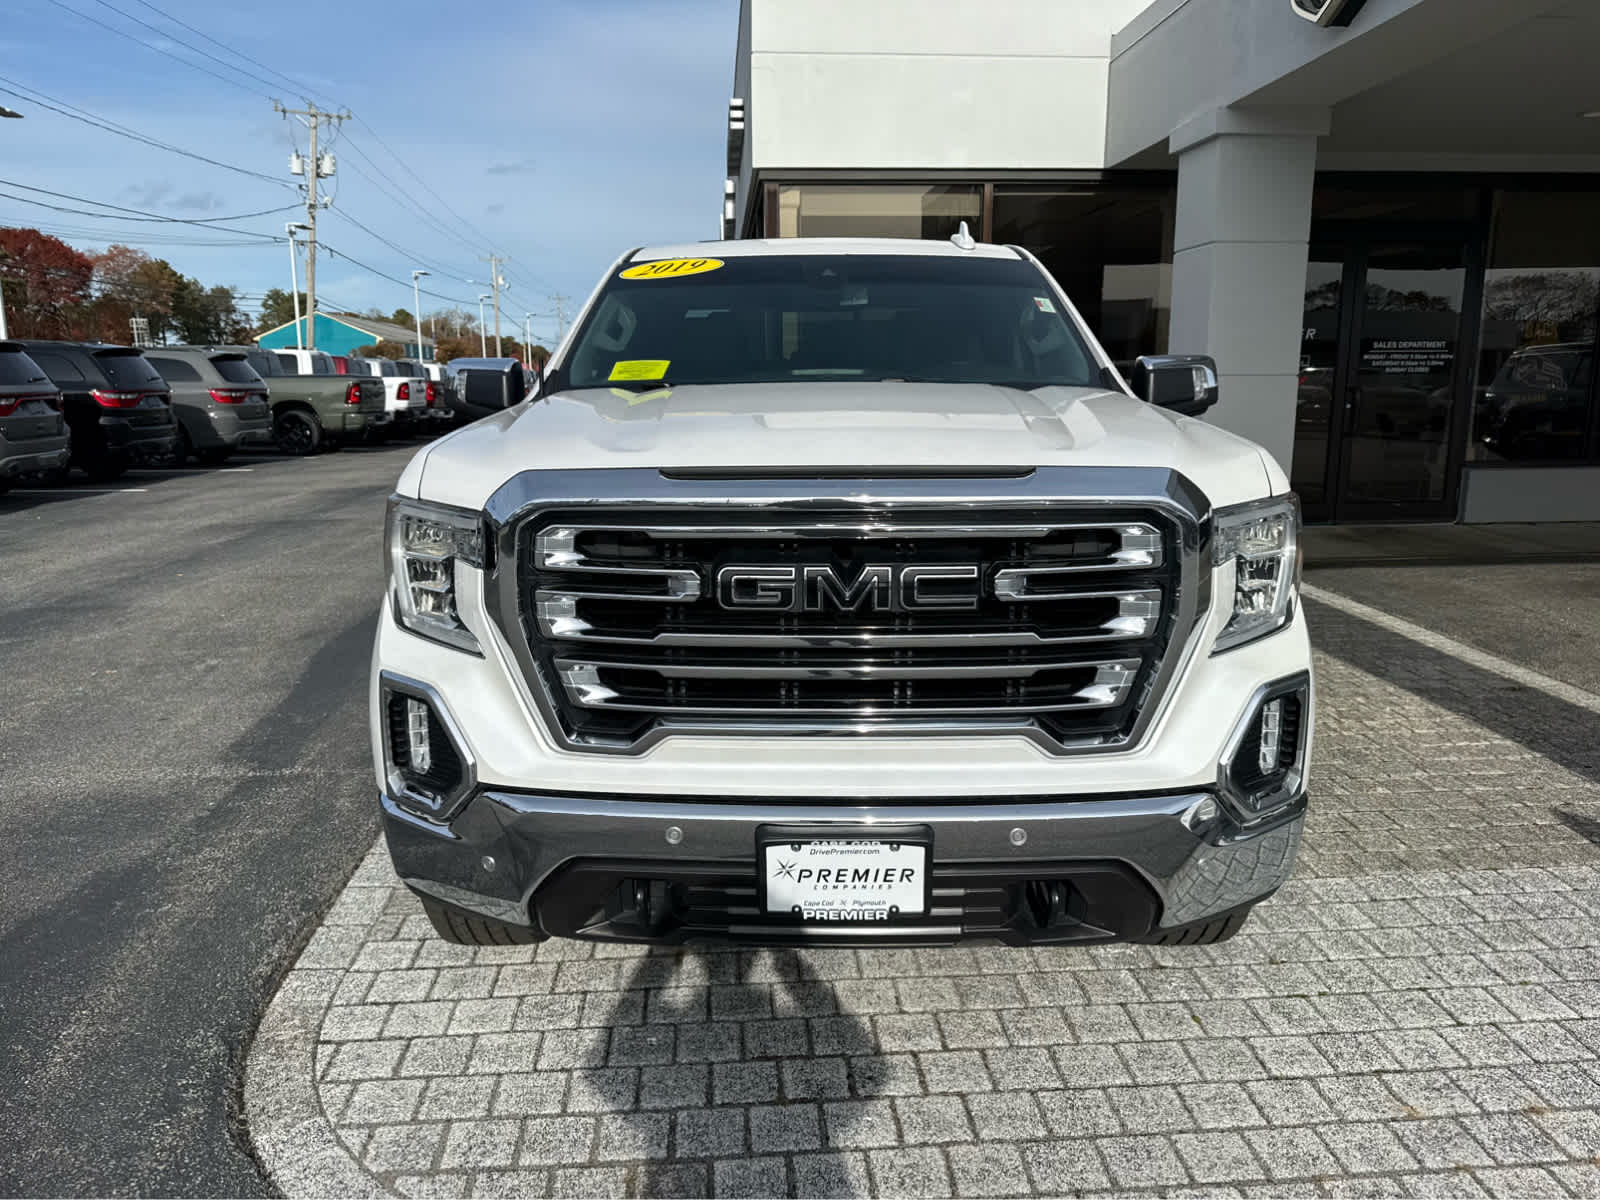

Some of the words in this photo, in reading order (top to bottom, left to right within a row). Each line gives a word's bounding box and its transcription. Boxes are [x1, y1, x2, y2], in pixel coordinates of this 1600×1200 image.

[634, 259, 708, 277] 2019
[1373, 341, 1397, 349] SALES
[1399, 340, 1446, 349] DEPARTMENT
[716, 563, 978, 611] GMC
[796, 868, 915, 883] PREMIER
[803, 899, 820, 907] Cape
[852, 899, 886, 907] Plymouth
[802, 909, 888, 920] PREMIER
